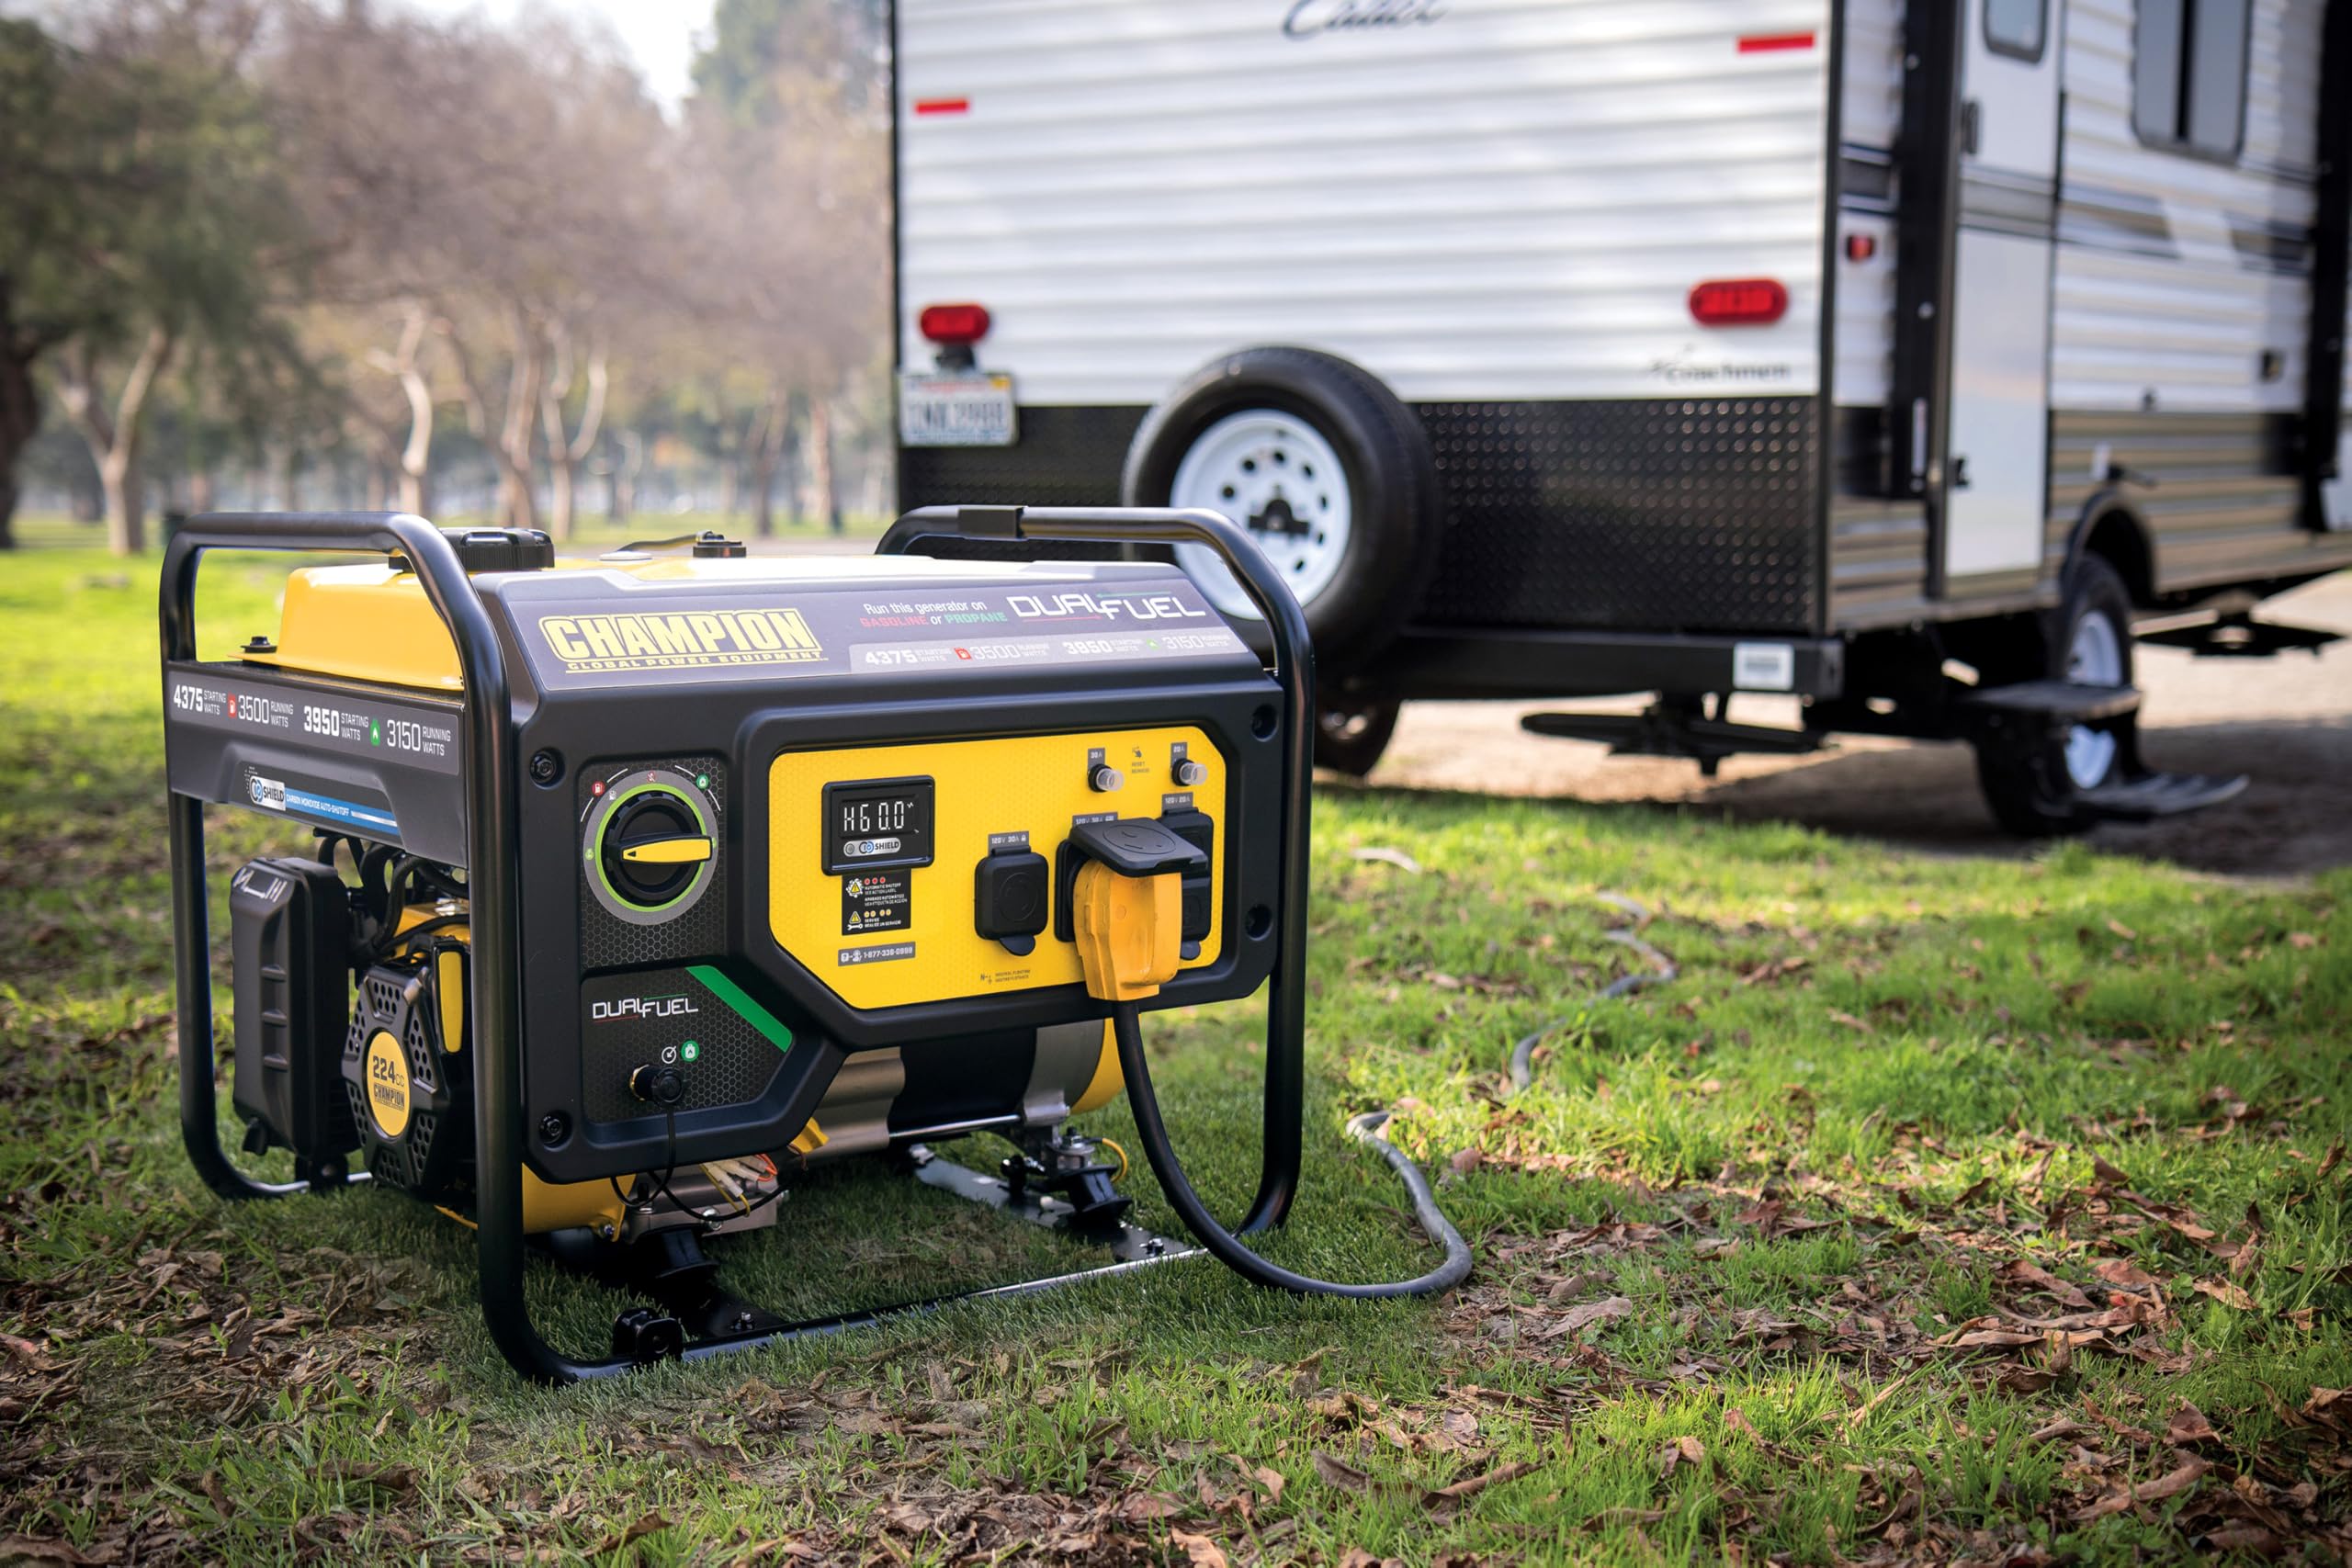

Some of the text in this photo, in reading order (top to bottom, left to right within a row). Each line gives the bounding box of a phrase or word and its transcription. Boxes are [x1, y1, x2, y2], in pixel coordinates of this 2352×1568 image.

[863, 600, 988, 615] Run this generator on
[859, 611, 1008, 628] GASOLINE or PROPANE
[543, 610, 817, 659] CHAMPION
[865, 649, 918, 665] 4375
[968, 644, 1021, 660] 3500
[1160, 635, 1205, 649] 3150
[567, 651, 821, 671] GLOBAL POWER EQUIPMENT
[173, 684, 451, 752] 4375 STARTING 3500 RUNNING 3950 STARTING 3150 RUNNING
[203, 704, 446, 757] WATTS WATTS WATTS WATTS
[263, 785, 285, 803] SHIELD
[875, 840, 899, 851] SHIELD
